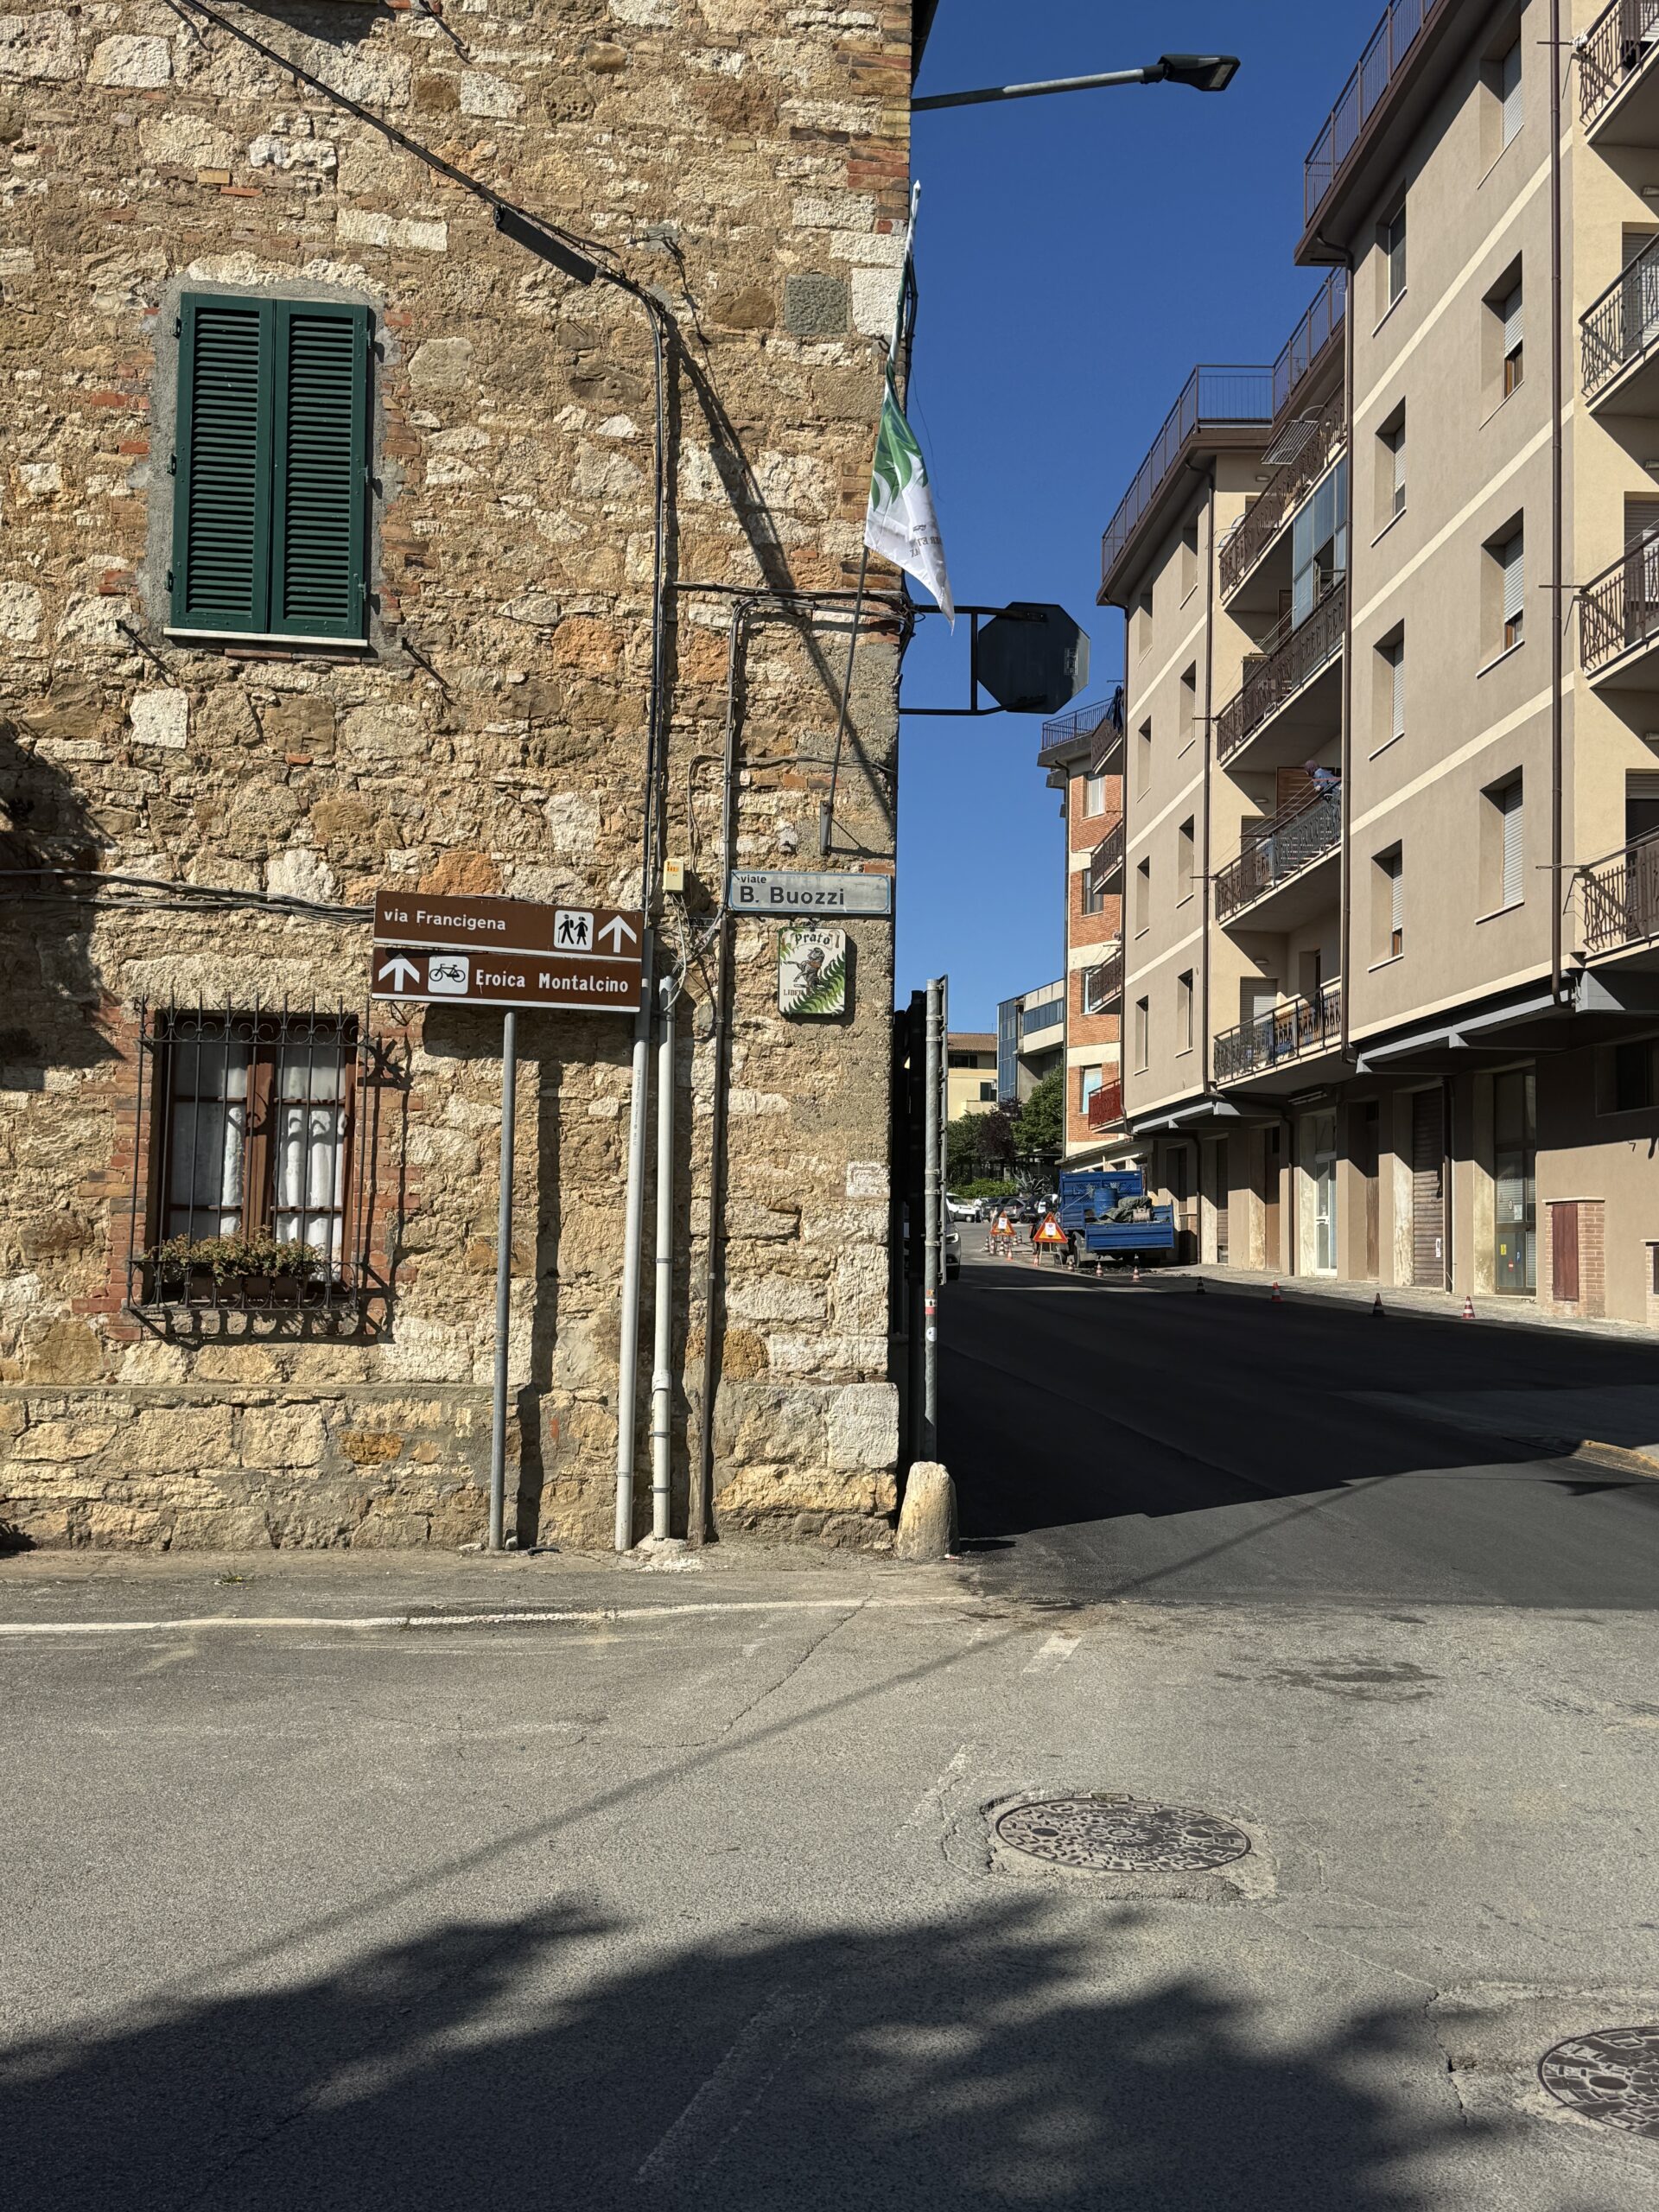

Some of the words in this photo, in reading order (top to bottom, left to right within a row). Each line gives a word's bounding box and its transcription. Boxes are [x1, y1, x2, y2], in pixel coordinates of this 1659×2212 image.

[741, 874, 766, 883] viale
[740, 886, 760, 903] B.
[770, 887, 844, 905] Buozzi
[384, 908, 408, 922] via
[416, 910, 506, 931] Francigena
[475, 969, 525, 988] Eroica
[538, 972, 628, 993] Montalcino
